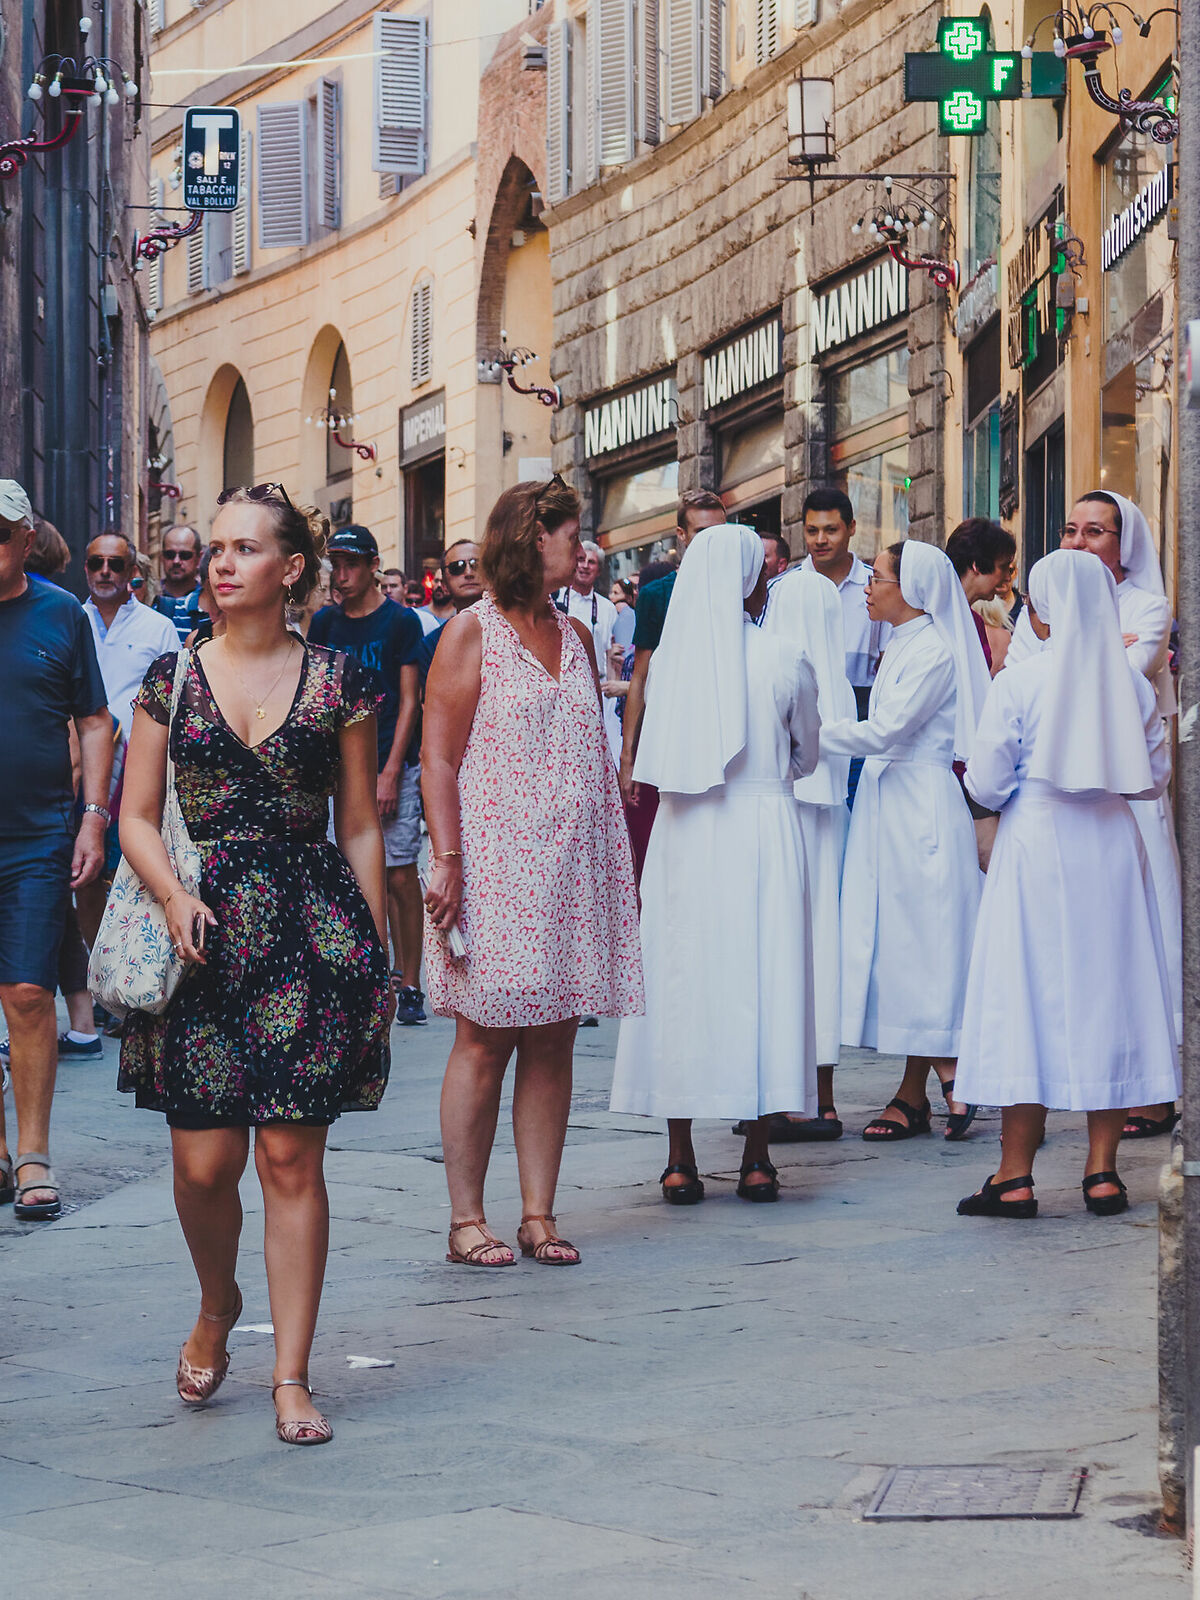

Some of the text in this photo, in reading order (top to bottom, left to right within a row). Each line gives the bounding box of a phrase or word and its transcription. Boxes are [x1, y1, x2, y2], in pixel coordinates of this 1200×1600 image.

[993, 59, 1014, 92] F
[192, 114, 233, 175] T
[187, 184, 236, 196] TABACCHI
[196, 175, 228, 184] SALI E
[203, 196, 236, 206] BOLLATI
[1101, 163, 1168, 273] intimissimi
[810, 255, 906, 356] NANNINI
[703, 318, 779, 411] NANNINI
[585, 378, 671, 459] NANNINI
